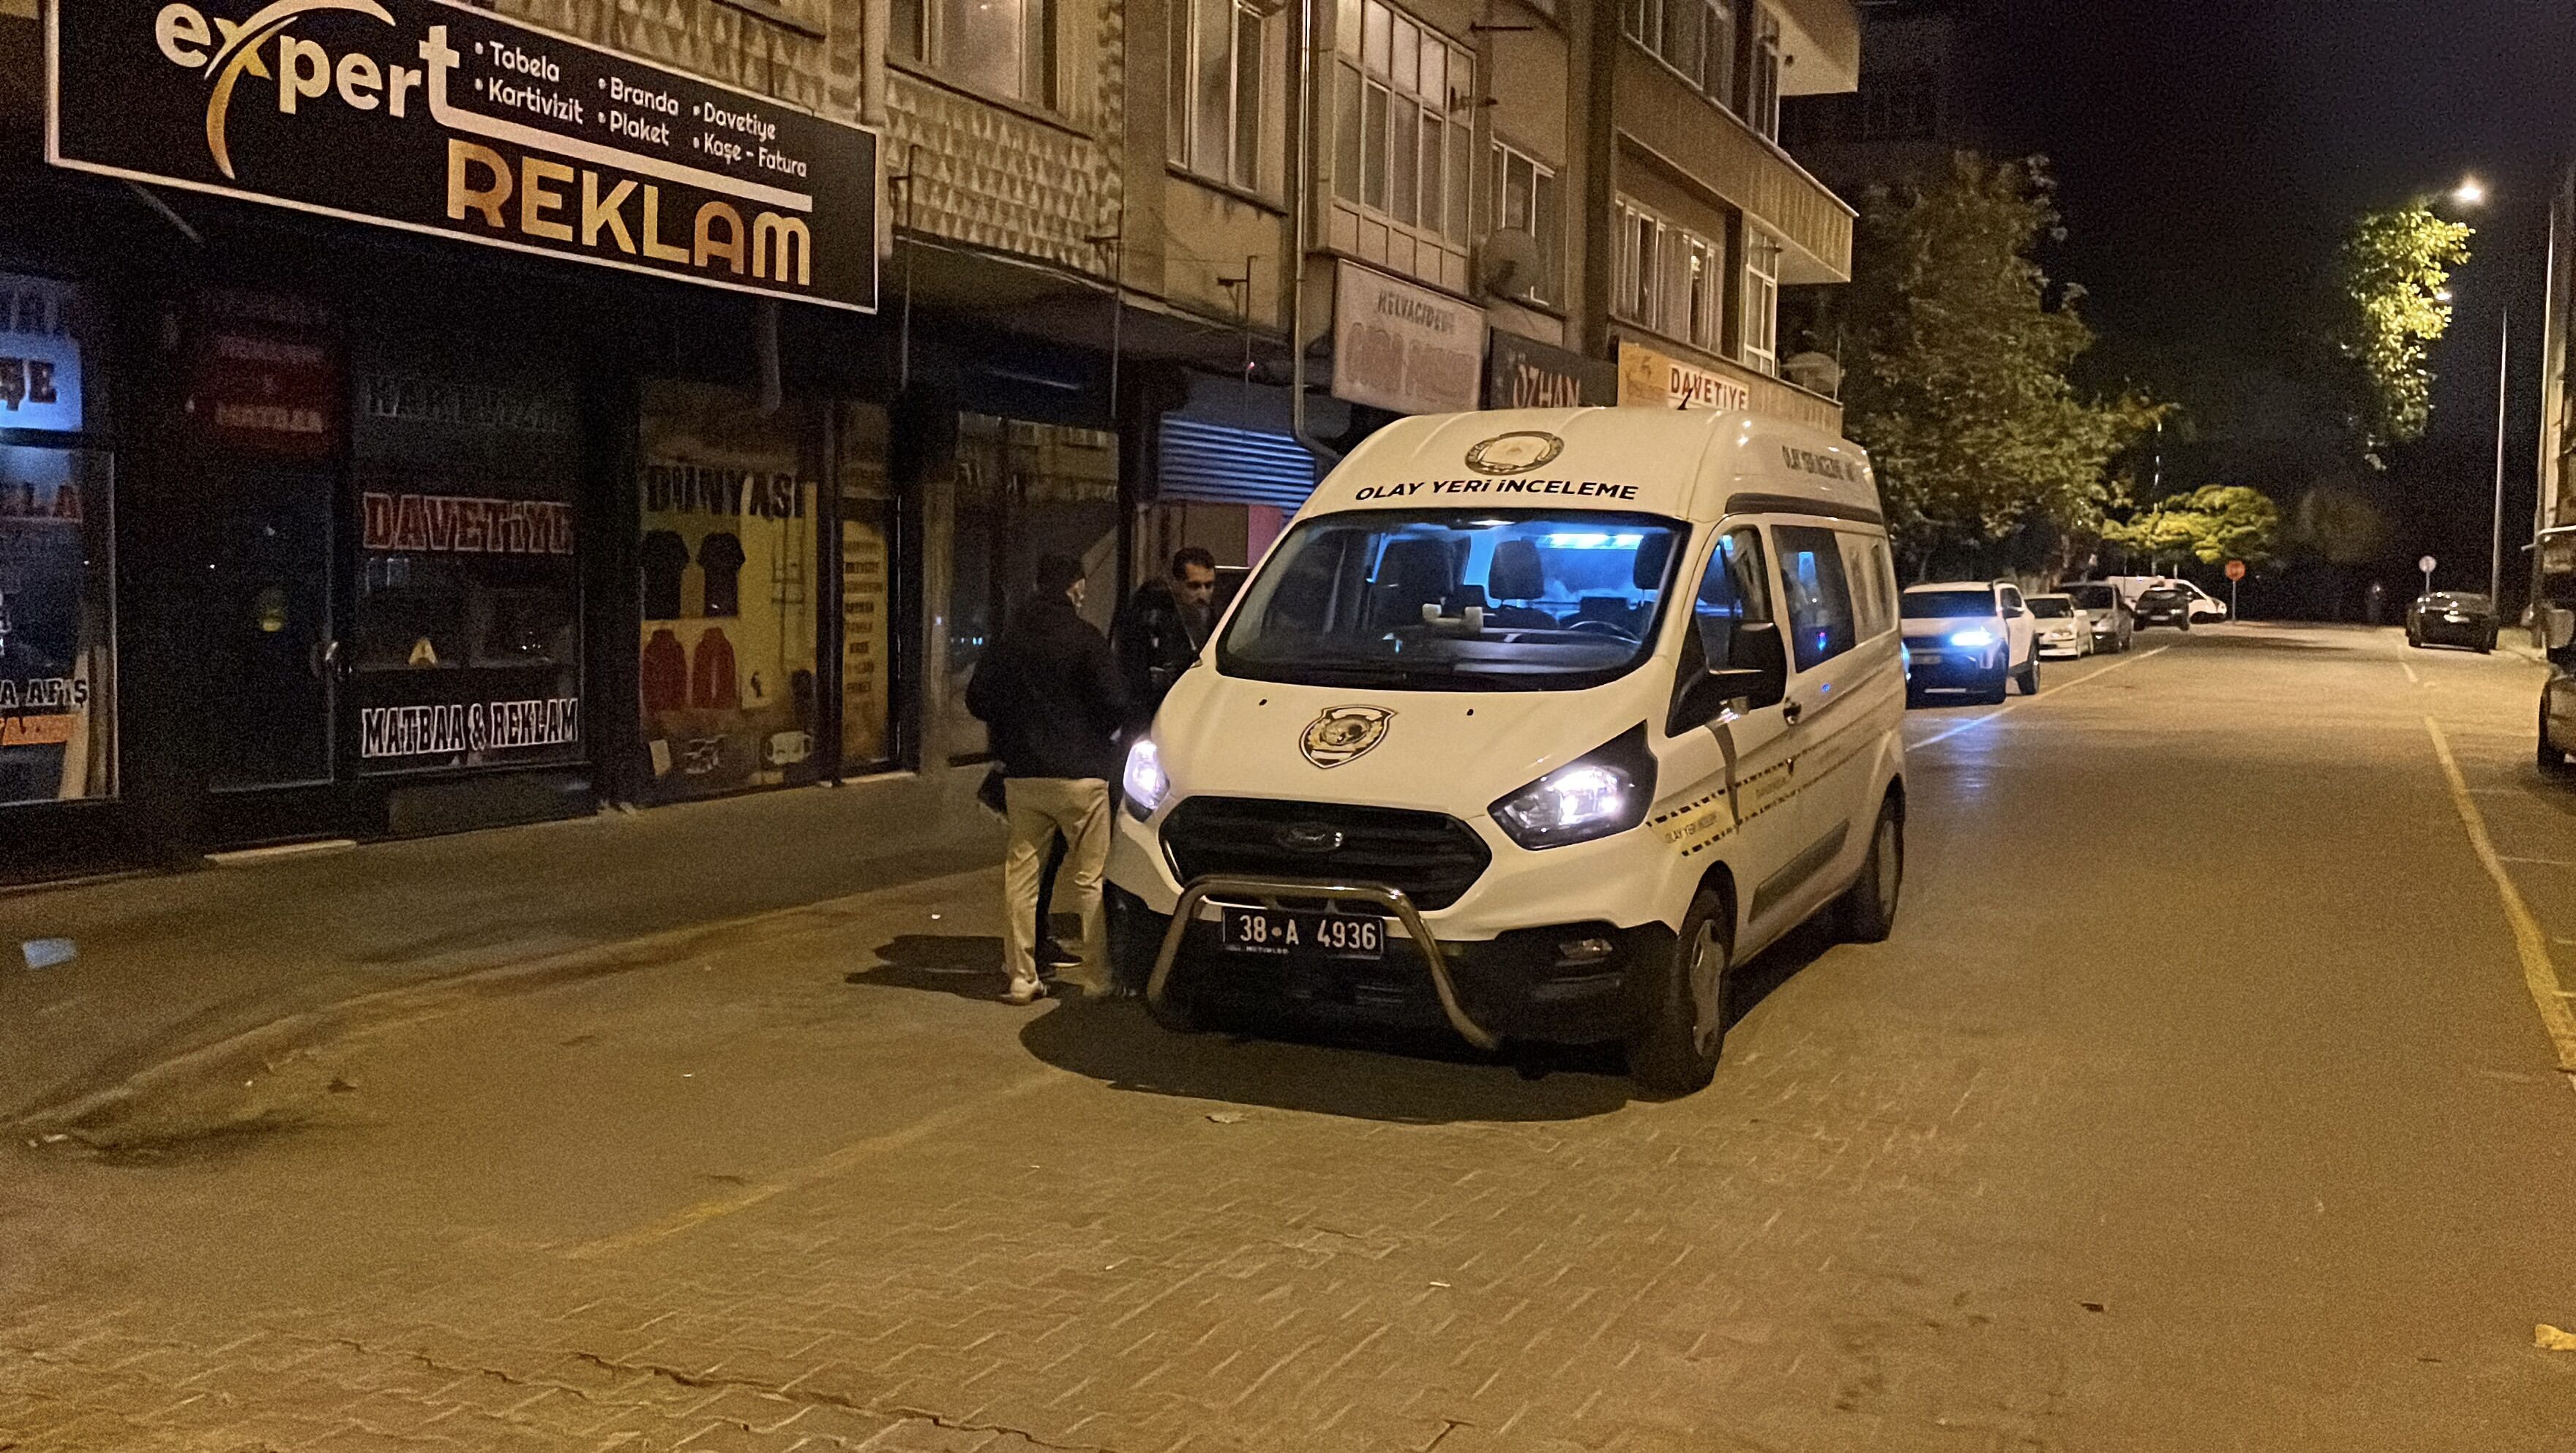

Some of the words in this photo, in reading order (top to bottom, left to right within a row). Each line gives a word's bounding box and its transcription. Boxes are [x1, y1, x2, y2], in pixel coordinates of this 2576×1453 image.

[489, 42, 560, 83] Tabela
[489, 78, 583, 125] Kartivizit
[610, 77, 678, 116] Branda
[610, 112, 670, 146] Plaket
[704, 102, 776, 142] Davetiye
[704, 133, 742, 164] Kaşe
[759, 145, 806, 178] Fatura
[447, 138, 810, 286] REKLAM
[1355, 482, 1425, 500] OLAY
[362, 704, 466, 757] MATBAA
[491, 698, 578, 749] REKLAM
[1239, 914, 1268, 942] 38
[1317, 919, 1376, 950] 4936
